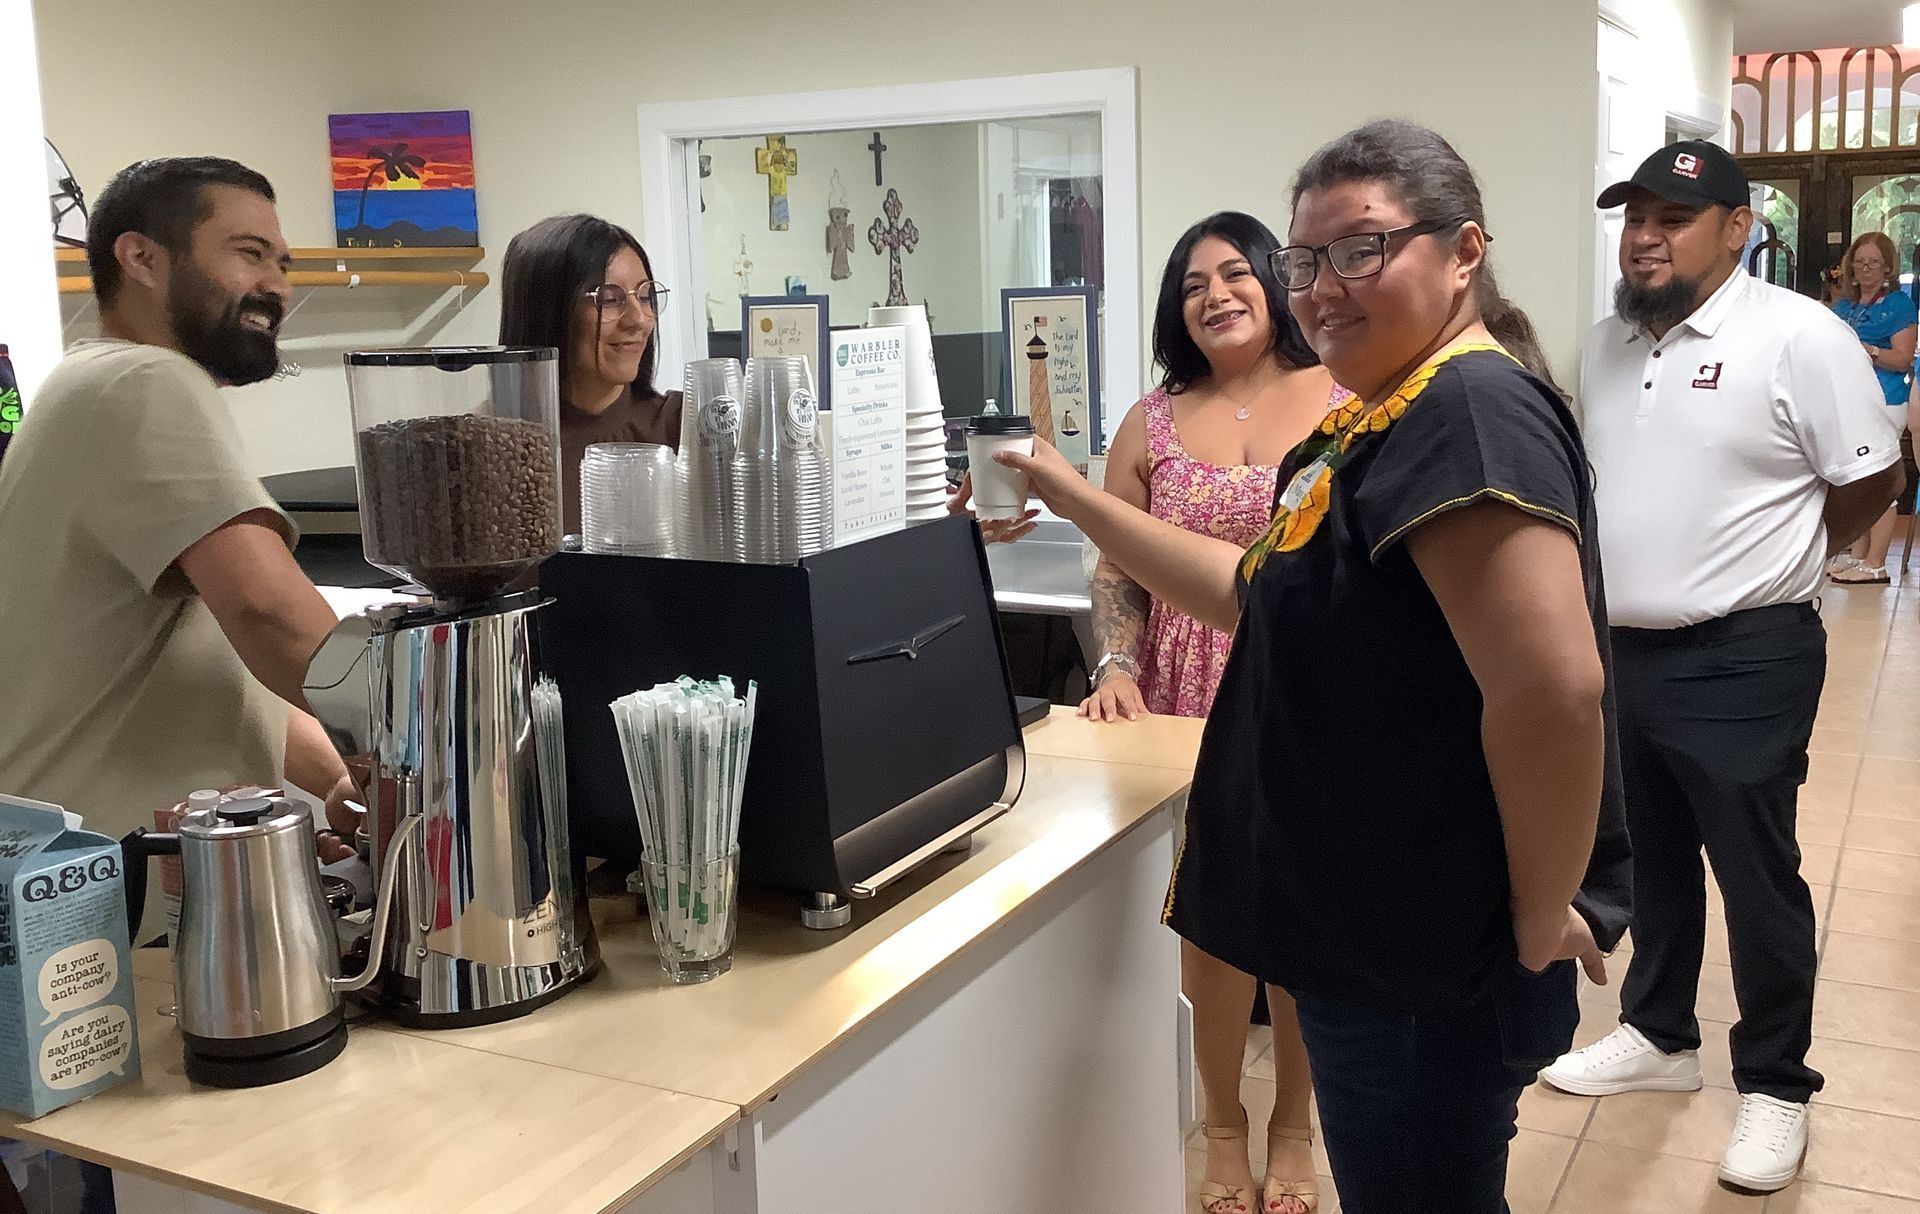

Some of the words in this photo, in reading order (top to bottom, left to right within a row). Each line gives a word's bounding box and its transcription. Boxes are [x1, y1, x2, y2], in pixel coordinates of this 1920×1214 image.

[764, 337, 783, 347] make
[851, 339, 900, 354] WARBLER
[851, 351, 885, 365] COFFEE
[887, 350, 901, 361] CO.
[877, 366, 886, 375] Bar
[22, 854, 120, 903] Q&Q
[50, 961, 106, 989] company
[55, 961, 68, 975] Is
[69, 952, 100, 972] your
[51, 971, 111, 1002] anti-cow?
[47, 1035, 91, 1059] saying
[93, 1020, 126, 1041] dairy
[61, 1025, 85, 1041] Are
[87, 1015, 109, 1035] you
[50, 1067, 72, 1082] are
[74, 1042, 128, 1075] pro-cow?
[55, 1035, 119, 1068] companies
